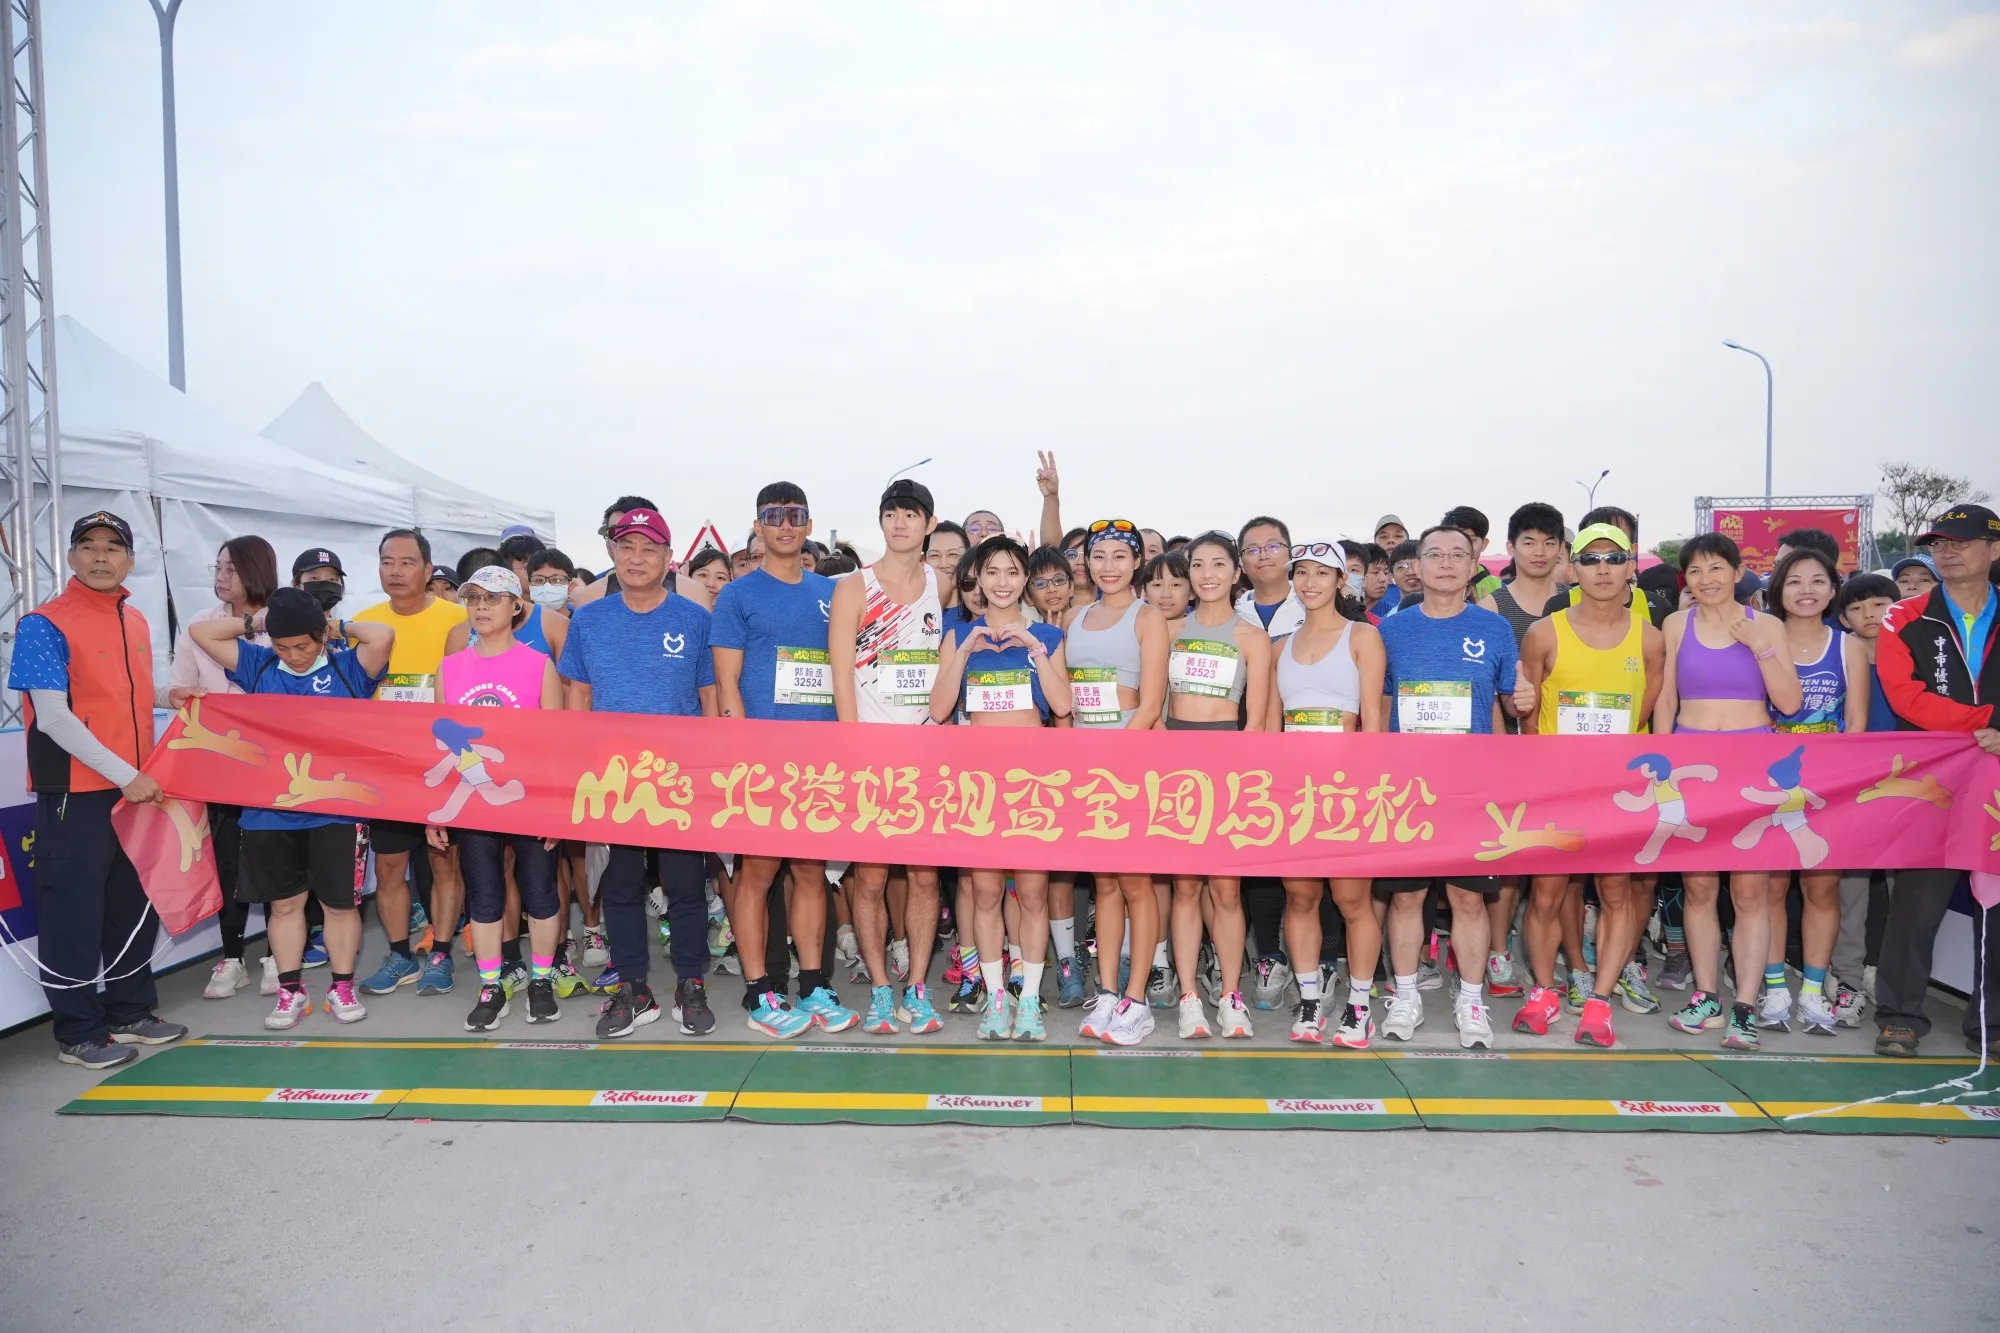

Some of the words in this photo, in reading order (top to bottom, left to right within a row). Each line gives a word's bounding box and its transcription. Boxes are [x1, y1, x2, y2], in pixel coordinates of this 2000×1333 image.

[1185, 667, 1216, 679] 32523
[794, 678, 822, 688] 32524
[896, 679, 926, 688] 32521
[496, 684, 518, 702] CHAN
[983, 701, 1015, 710] 32526
[1416, 711, 1451, 721] 30042
[1576, 722, 1611, 734] 30822
[711, 762, 1437, 850] 北港媽祖盃全國馬拉松
